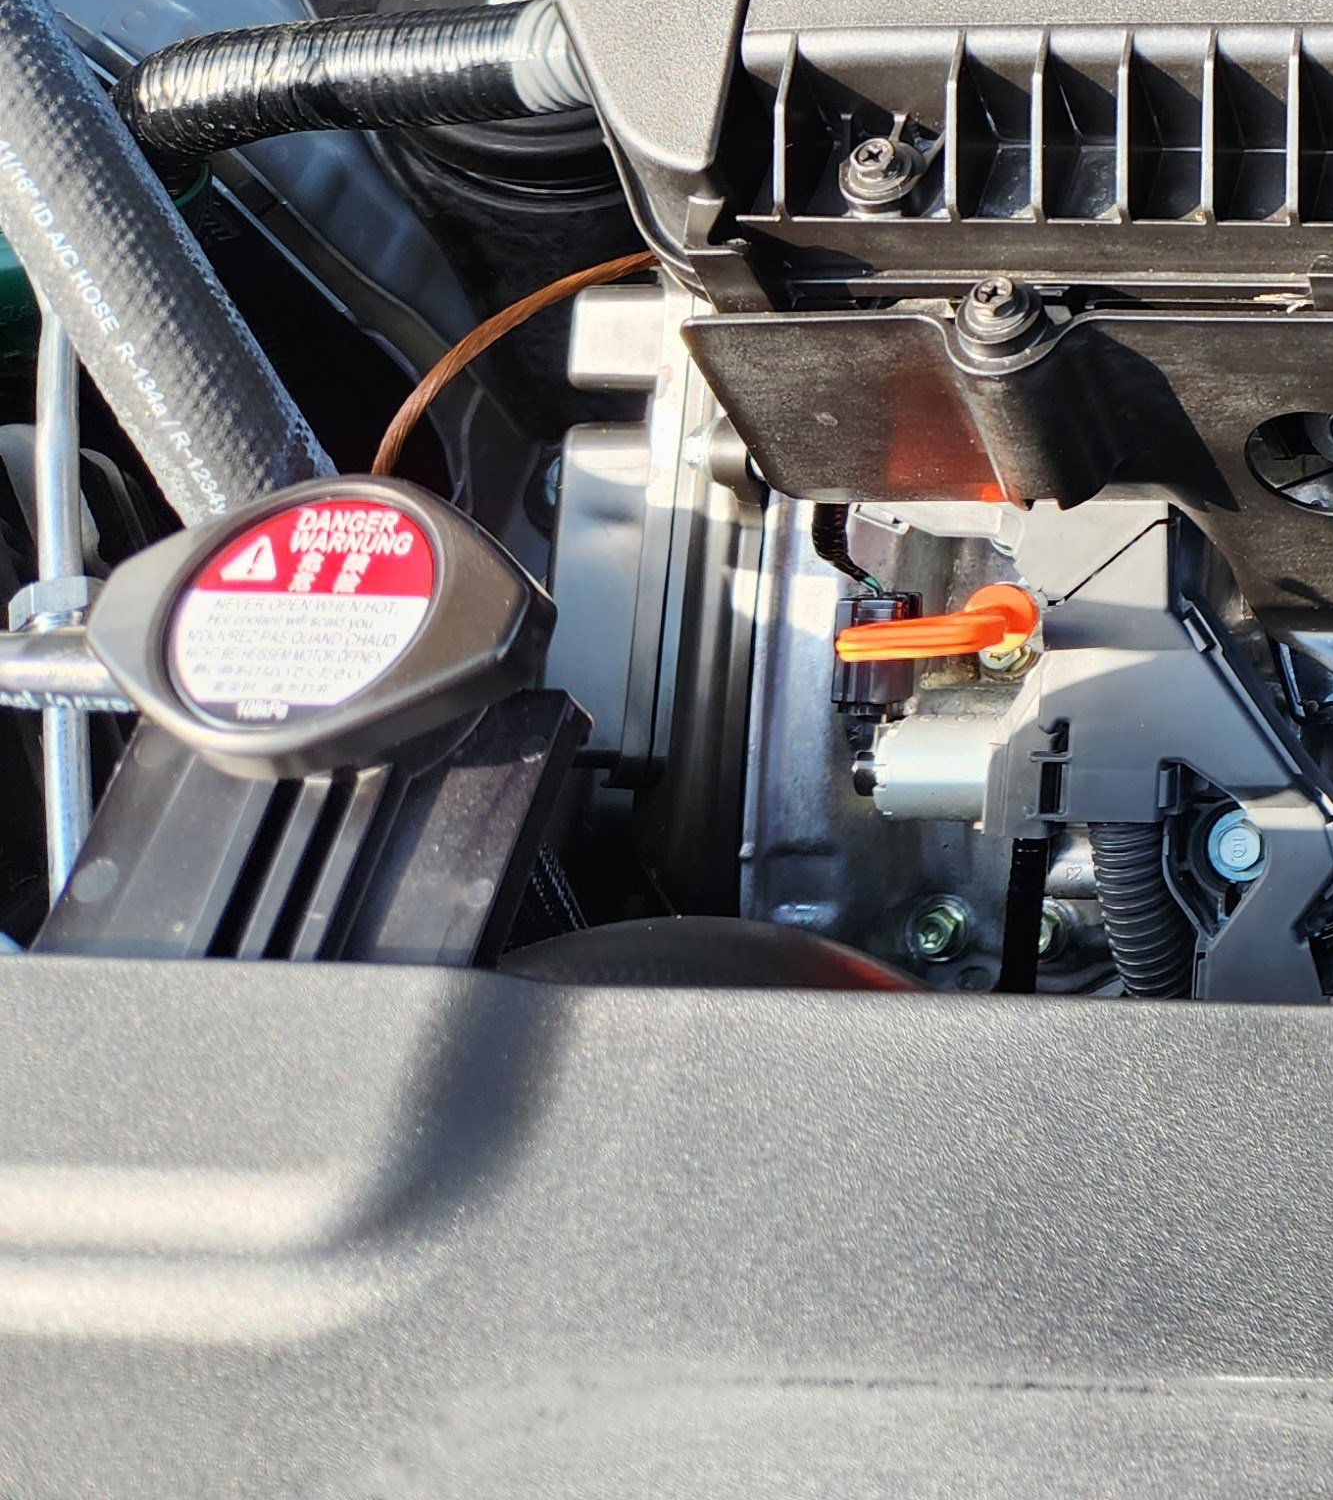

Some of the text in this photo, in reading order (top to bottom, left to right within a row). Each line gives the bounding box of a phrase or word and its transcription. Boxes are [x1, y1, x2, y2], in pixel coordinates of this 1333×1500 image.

[29, 199, 56, 228] ID
[48, 232, 80, 269] A/C
[72, 271, 121, 335] HOSE
[115, 341, 171, 417] R-134a
[297, 510, 401, 533] DANGER
[289, 530, 414, 556] WARNUNG
[214, 597, 264, 610] NEVER
[269, 598, 309, 611] OPEN
[315, 600, 360, 613] WHEN
